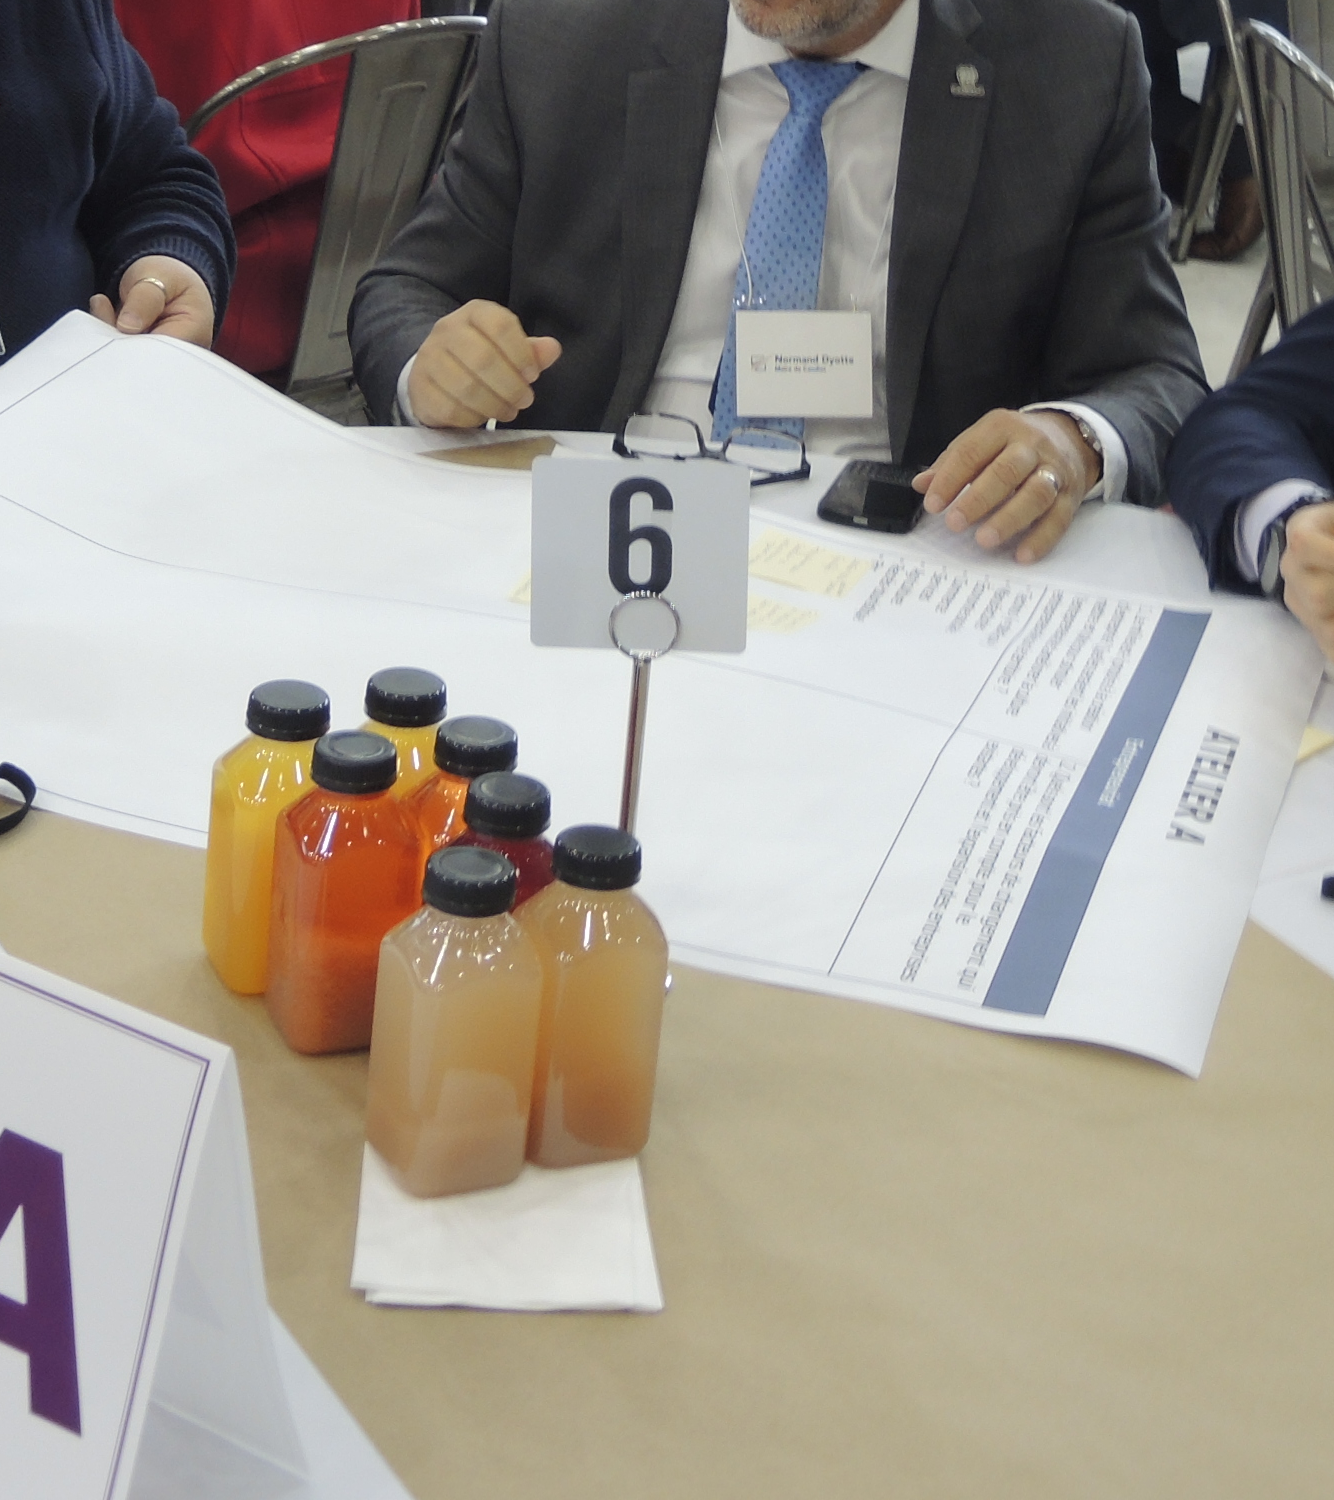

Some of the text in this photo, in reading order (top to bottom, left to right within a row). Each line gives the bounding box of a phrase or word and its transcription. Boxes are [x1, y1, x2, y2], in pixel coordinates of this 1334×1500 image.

[608, 476, 674, 596] 6
[1165, 725, 1240, 846] ATELIER A
